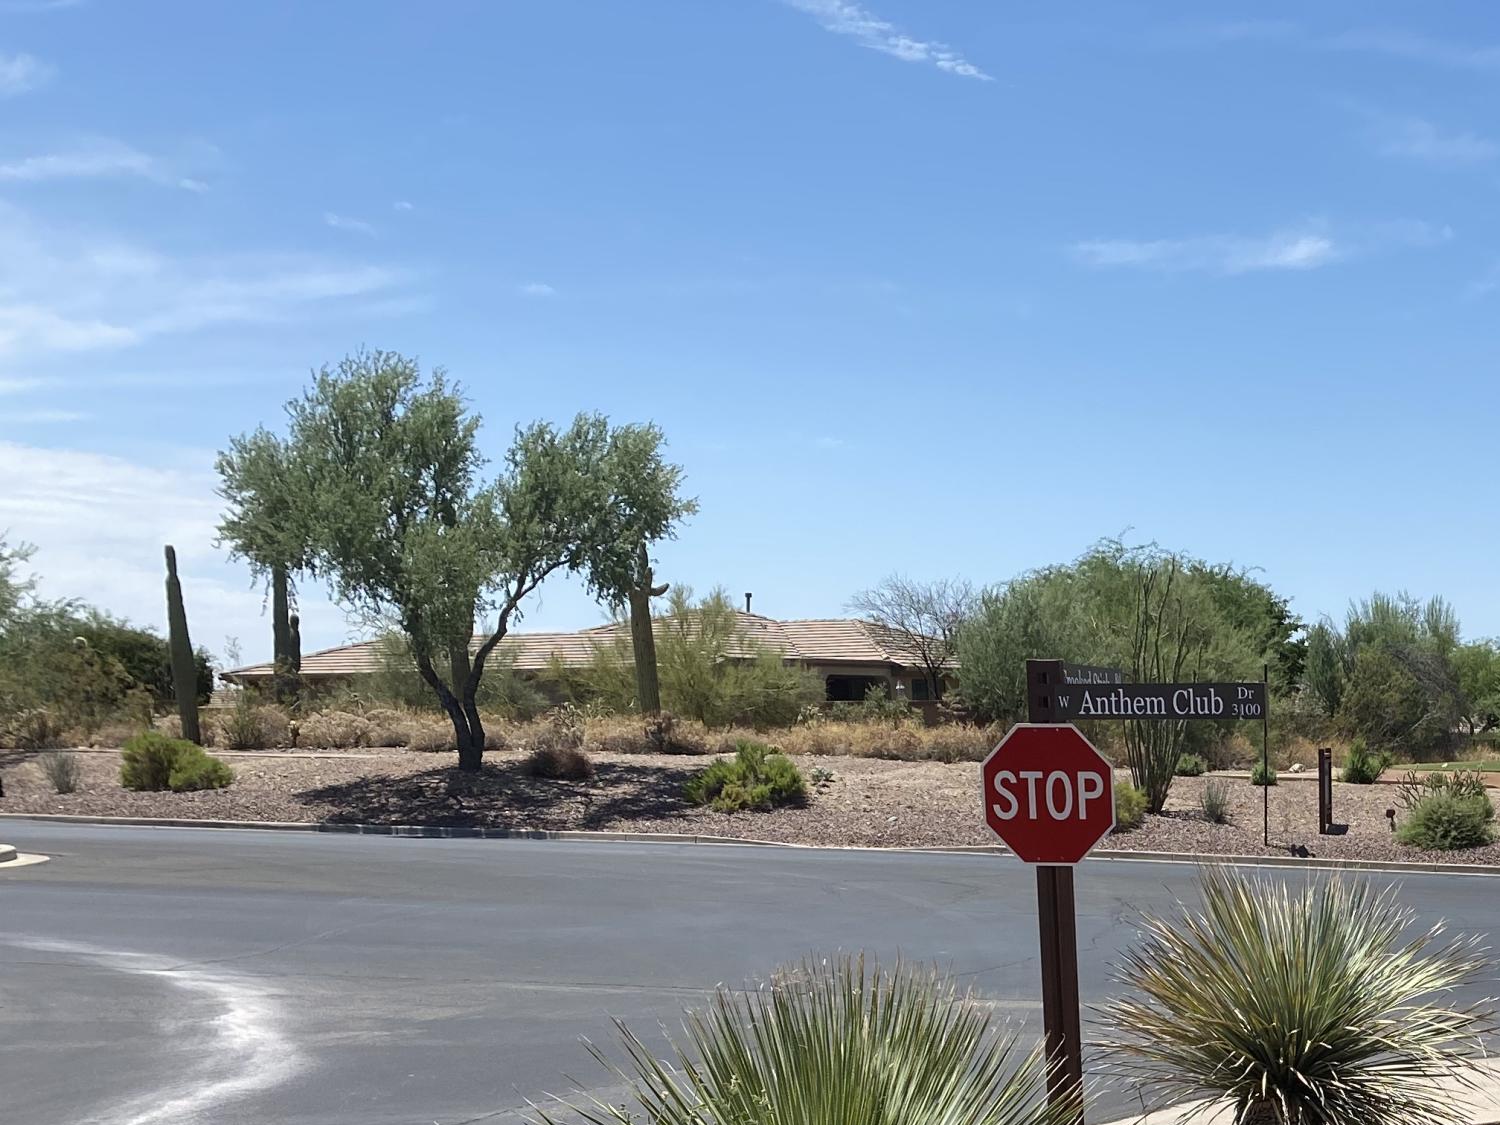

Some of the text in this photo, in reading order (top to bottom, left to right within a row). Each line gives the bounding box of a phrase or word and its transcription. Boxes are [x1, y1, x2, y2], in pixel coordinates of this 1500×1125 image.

[1058, 686, 1255, 716] W Anthem Club Dr
[1231, 703, 1261, 716] 3100
[992, 770, 1104, 821] STOP
